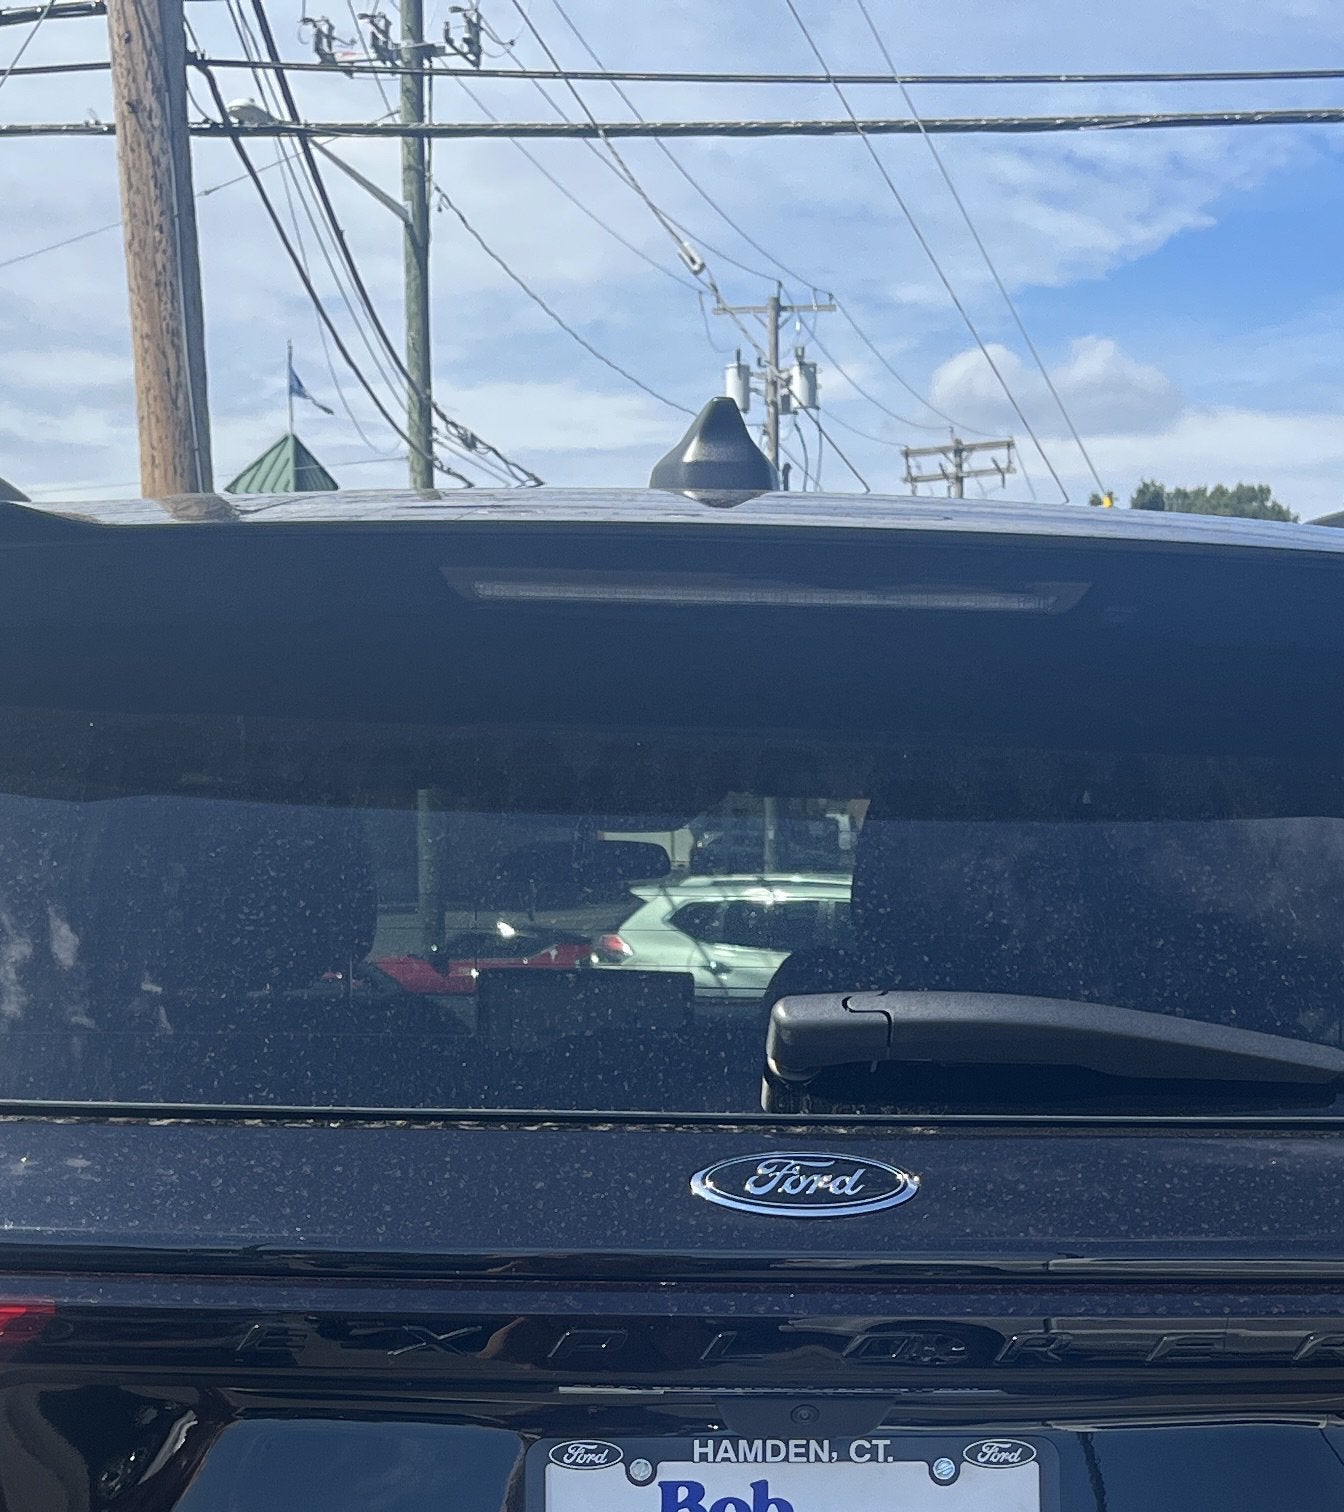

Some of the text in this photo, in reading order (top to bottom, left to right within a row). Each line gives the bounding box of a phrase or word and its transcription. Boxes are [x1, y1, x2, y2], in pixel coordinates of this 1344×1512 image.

[744, 1159, 867, 1195] Ford
[562, 1443, 610, 1464] Ford
[692, 1439, 894, 1464] HAMDEN, CT.
[976, 1442, 1023, 1463] Ford
